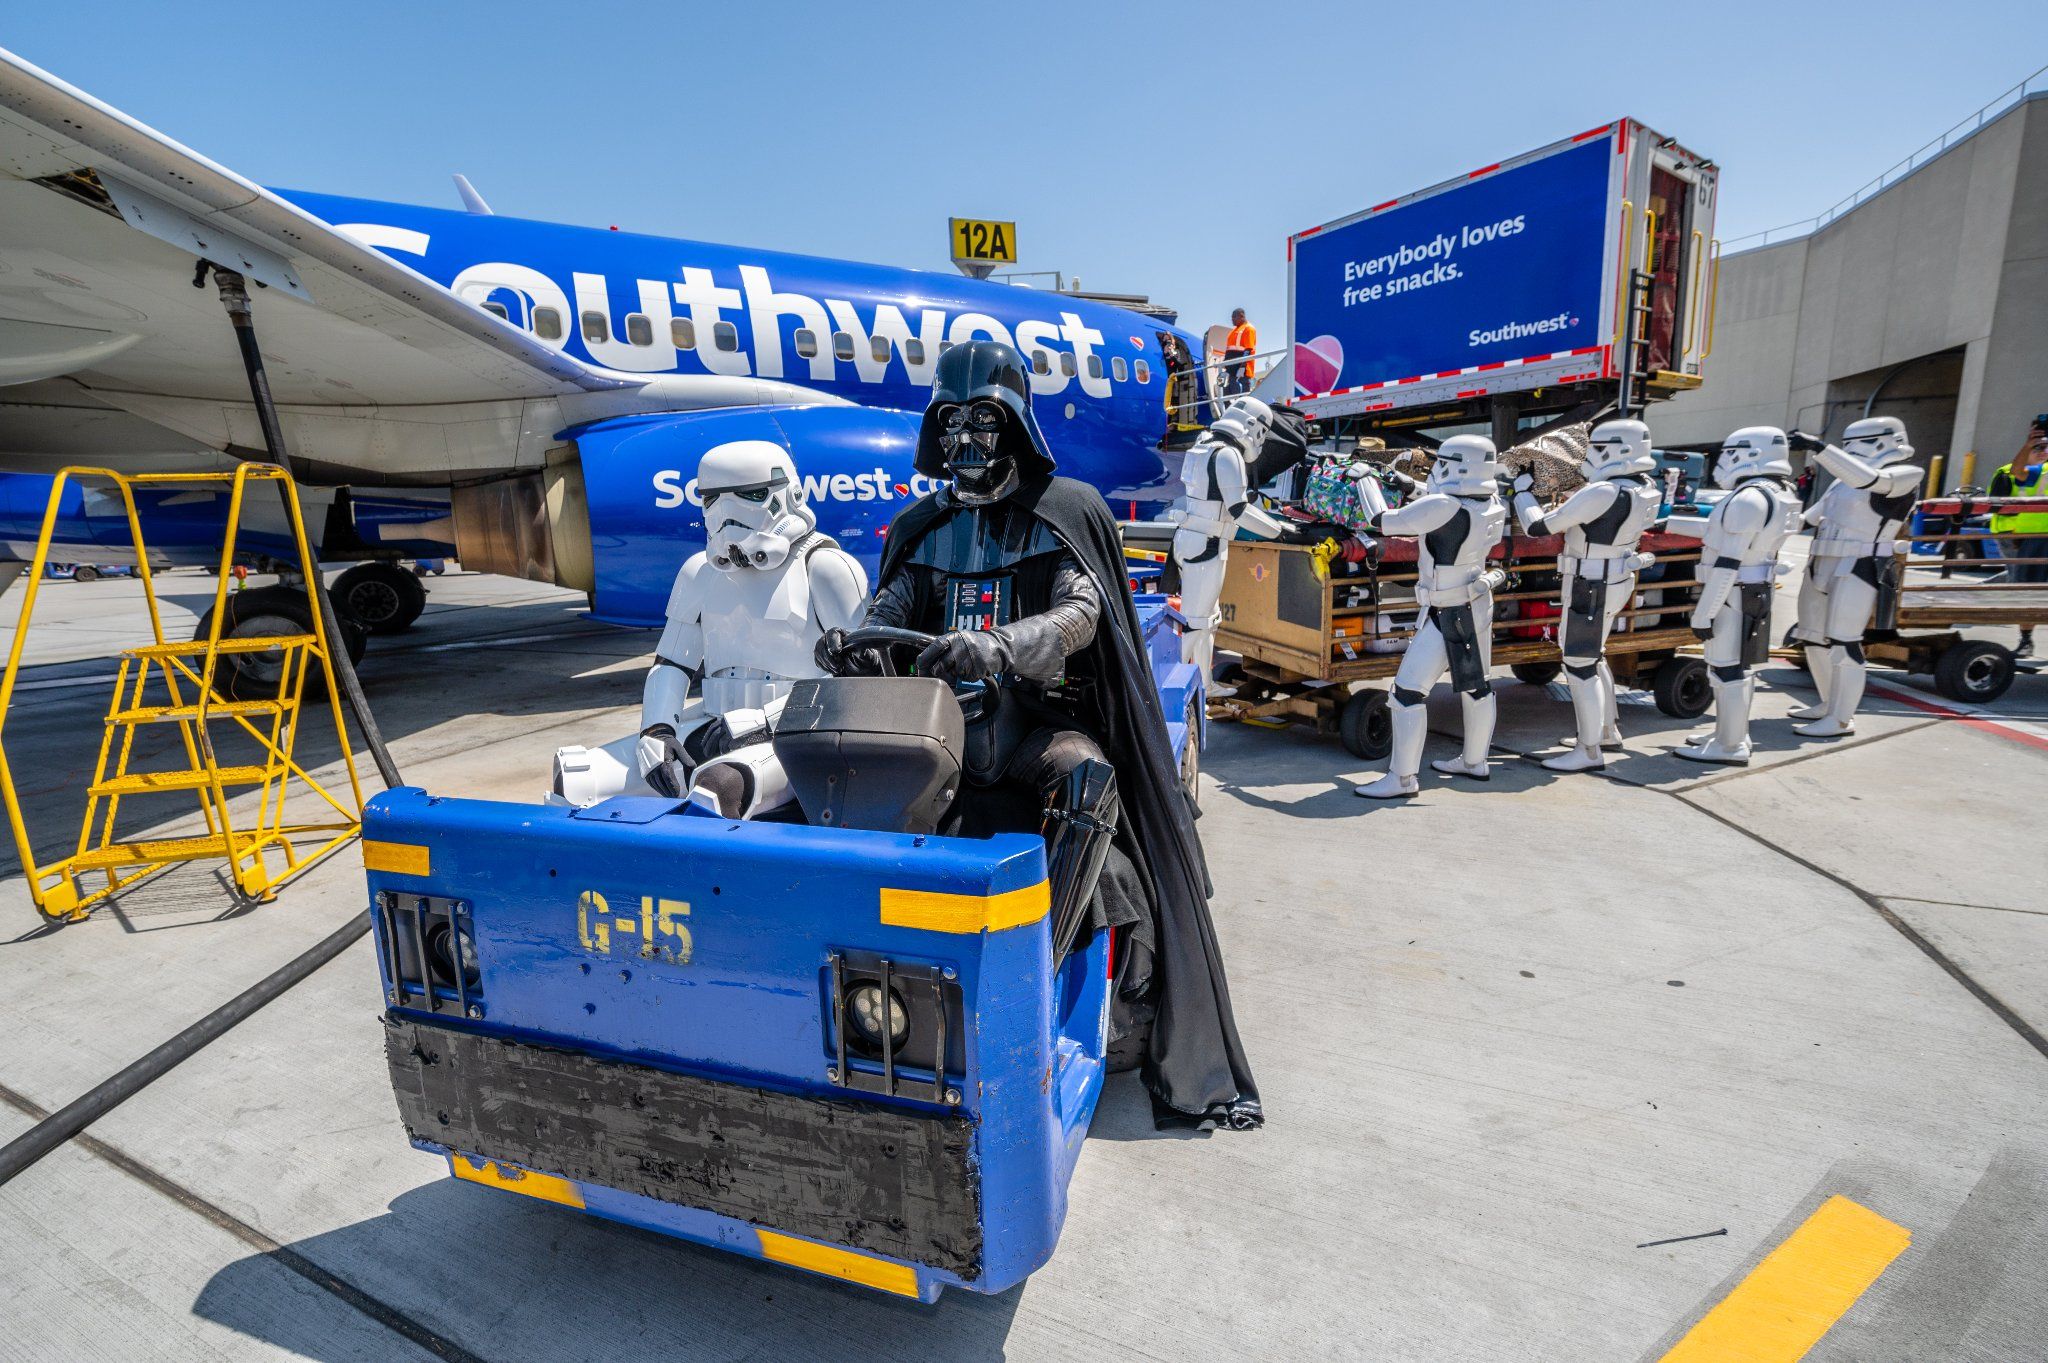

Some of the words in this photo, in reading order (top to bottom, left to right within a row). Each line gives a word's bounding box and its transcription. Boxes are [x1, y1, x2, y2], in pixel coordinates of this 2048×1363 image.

[960, 222, 1009, 260] 12A
[1344, 233, 1458, 282] Everybody
[1461, 214, 1526, 249] loves
[1342, 283, 1383, 307] free
[1385, 262, 1464, 297] snacks.
[1468, 313, 1569, 347] Southwest
[577, 890, 693, 965] G-15
